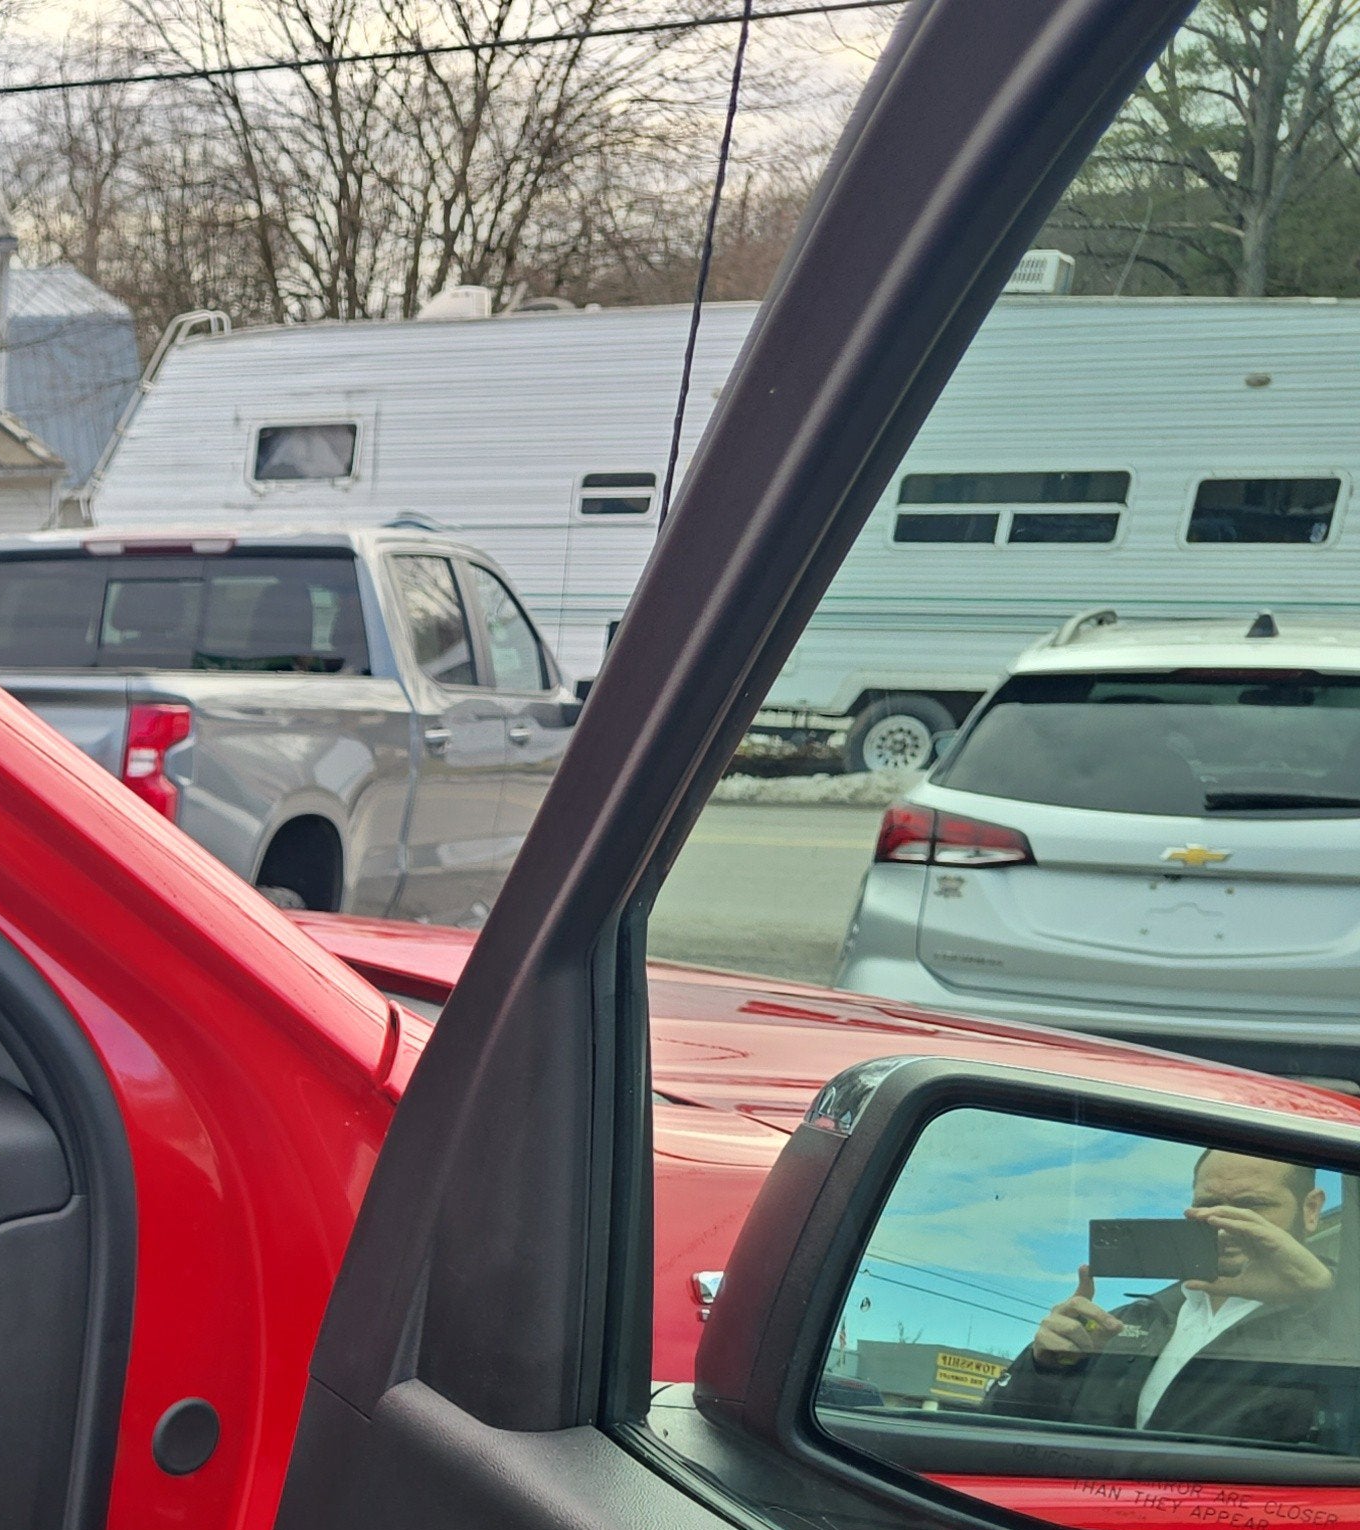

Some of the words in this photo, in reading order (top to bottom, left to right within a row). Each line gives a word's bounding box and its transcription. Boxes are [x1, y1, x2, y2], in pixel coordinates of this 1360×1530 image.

[1073, 1479, 1123, 1500] THAN
[1134, 1490, 1182, 1514] THEY
[1213, 1488, 1252, 1509] ARE
[1263, 1500, 1339, 1528] CLOSER
